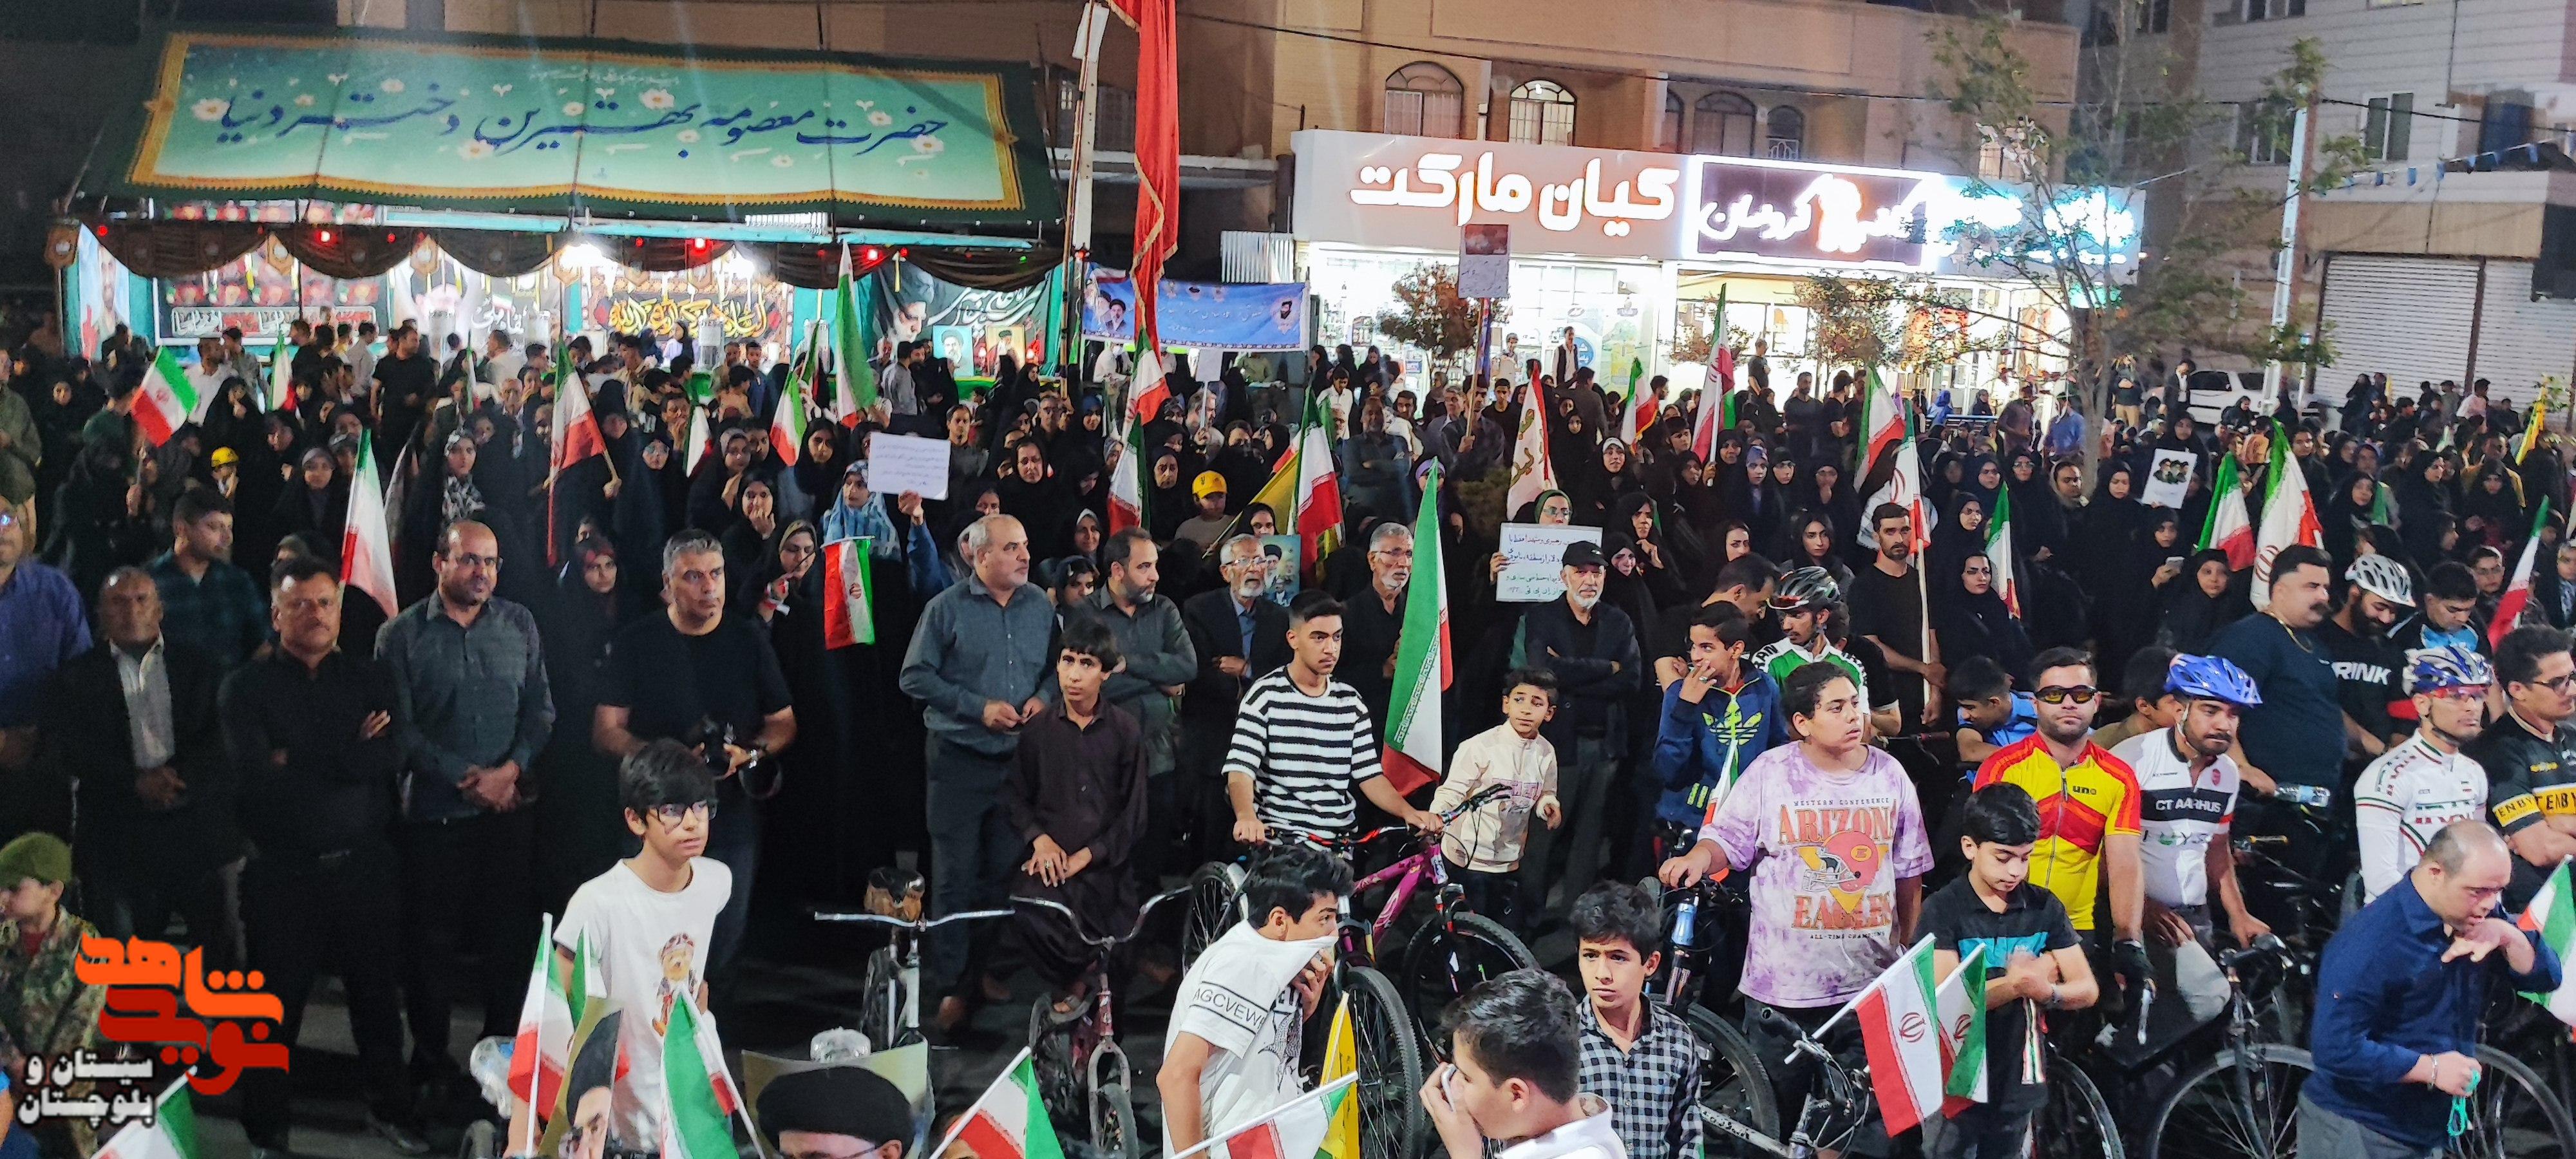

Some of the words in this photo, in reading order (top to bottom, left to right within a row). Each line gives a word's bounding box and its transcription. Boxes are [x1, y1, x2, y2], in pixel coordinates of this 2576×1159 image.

[217, 89, 285, 144] دنیا
[277, 82, 461, 137] دختر
[474, 100, 702, 159] بهترین
[699, 107, 815, 146] معصومه
[797, 105, 949, 157] حضرت
[1350, 151, 1532, 227] مارکت
[1537, 156, 1680, 237] کیان
[1754, 645, 1779, 669] RAN
[2318, 659, 2392, 686] RINK
[1839, 797, 1891, 806] CONFERENCE
[2072, 786, 2097, 795] uno
[2155, 799, 2174, 811] CT
[2175, 797, 2222, 813] AARHUS
